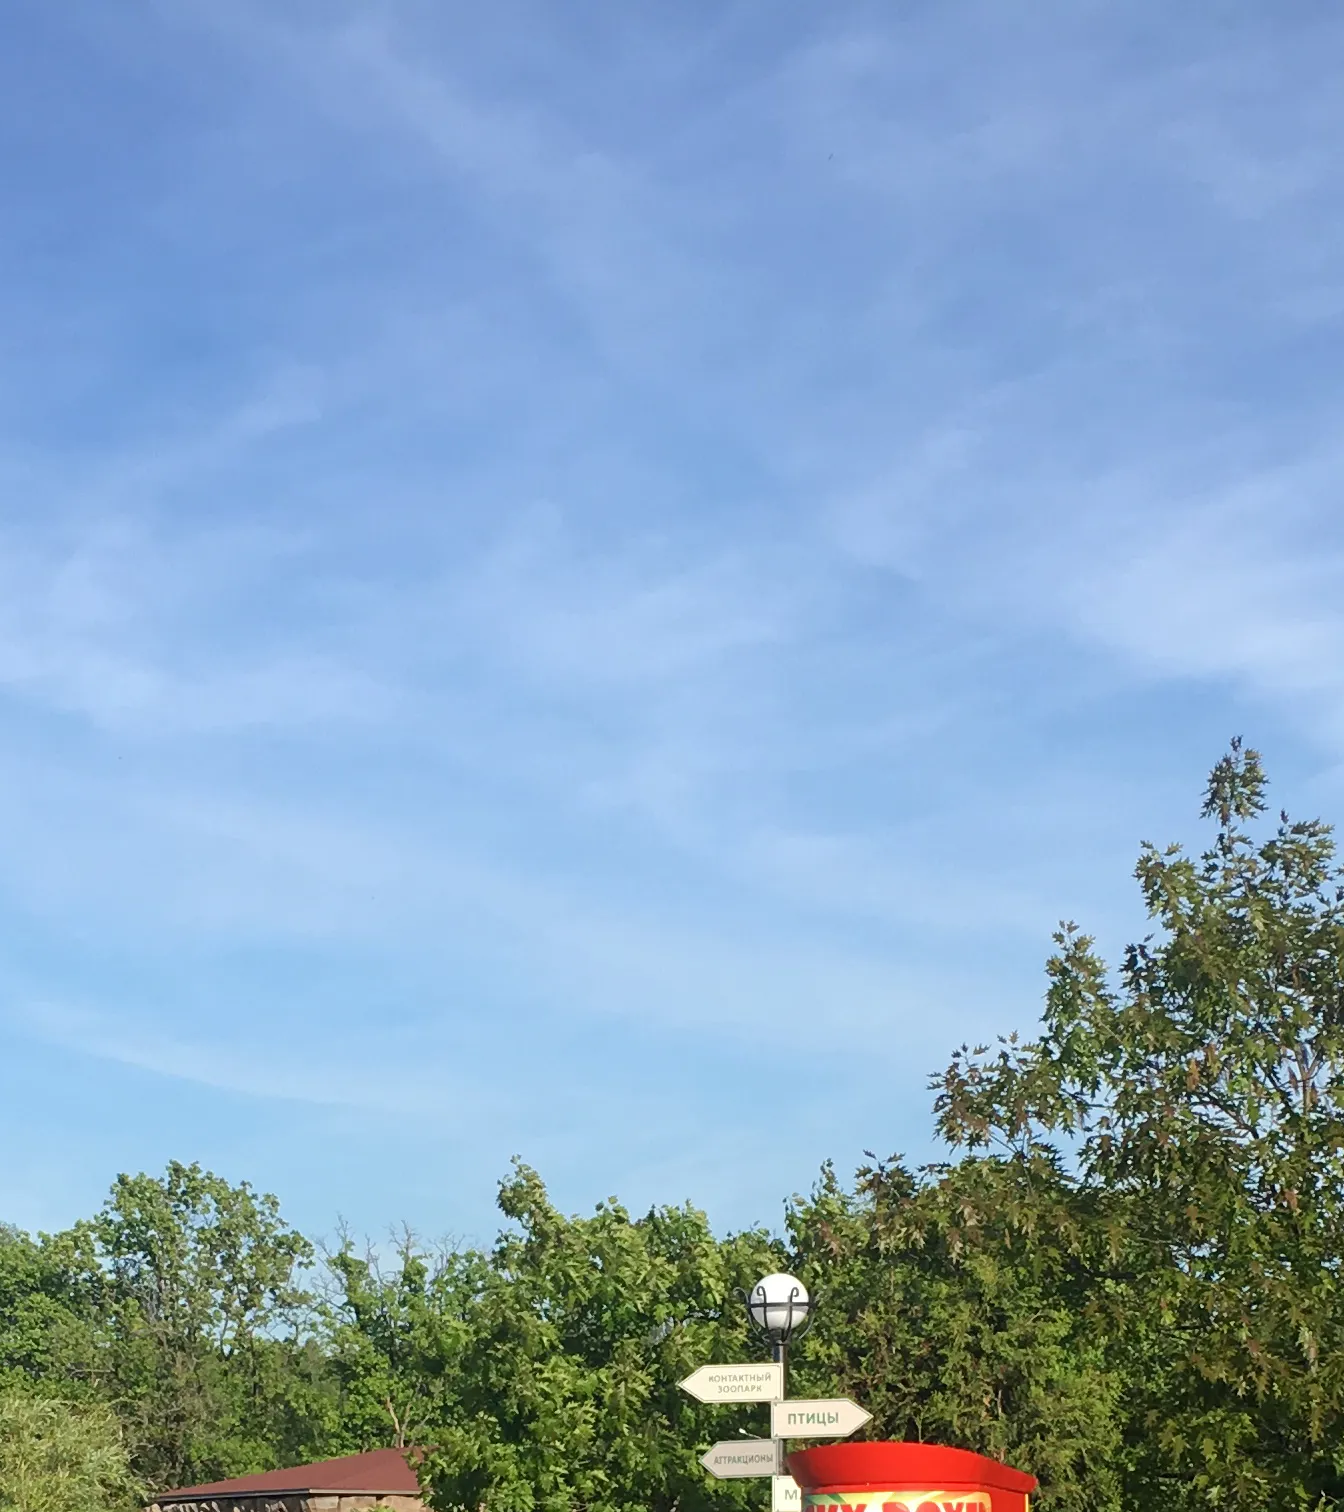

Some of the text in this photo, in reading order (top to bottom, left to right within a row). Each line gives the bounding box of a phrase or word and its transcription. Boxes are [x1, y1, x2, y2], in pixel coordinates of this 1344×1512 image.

[708, 1372, 771, 1383] КОНТАКТНЫЙ
[717, 1385, 762, 1394] ЗООПАРК
[787, 1412, 839, 1427] ПТИЦЫ
[713, 1454, 774, 1466] АТТРАКЦИОНЫ
